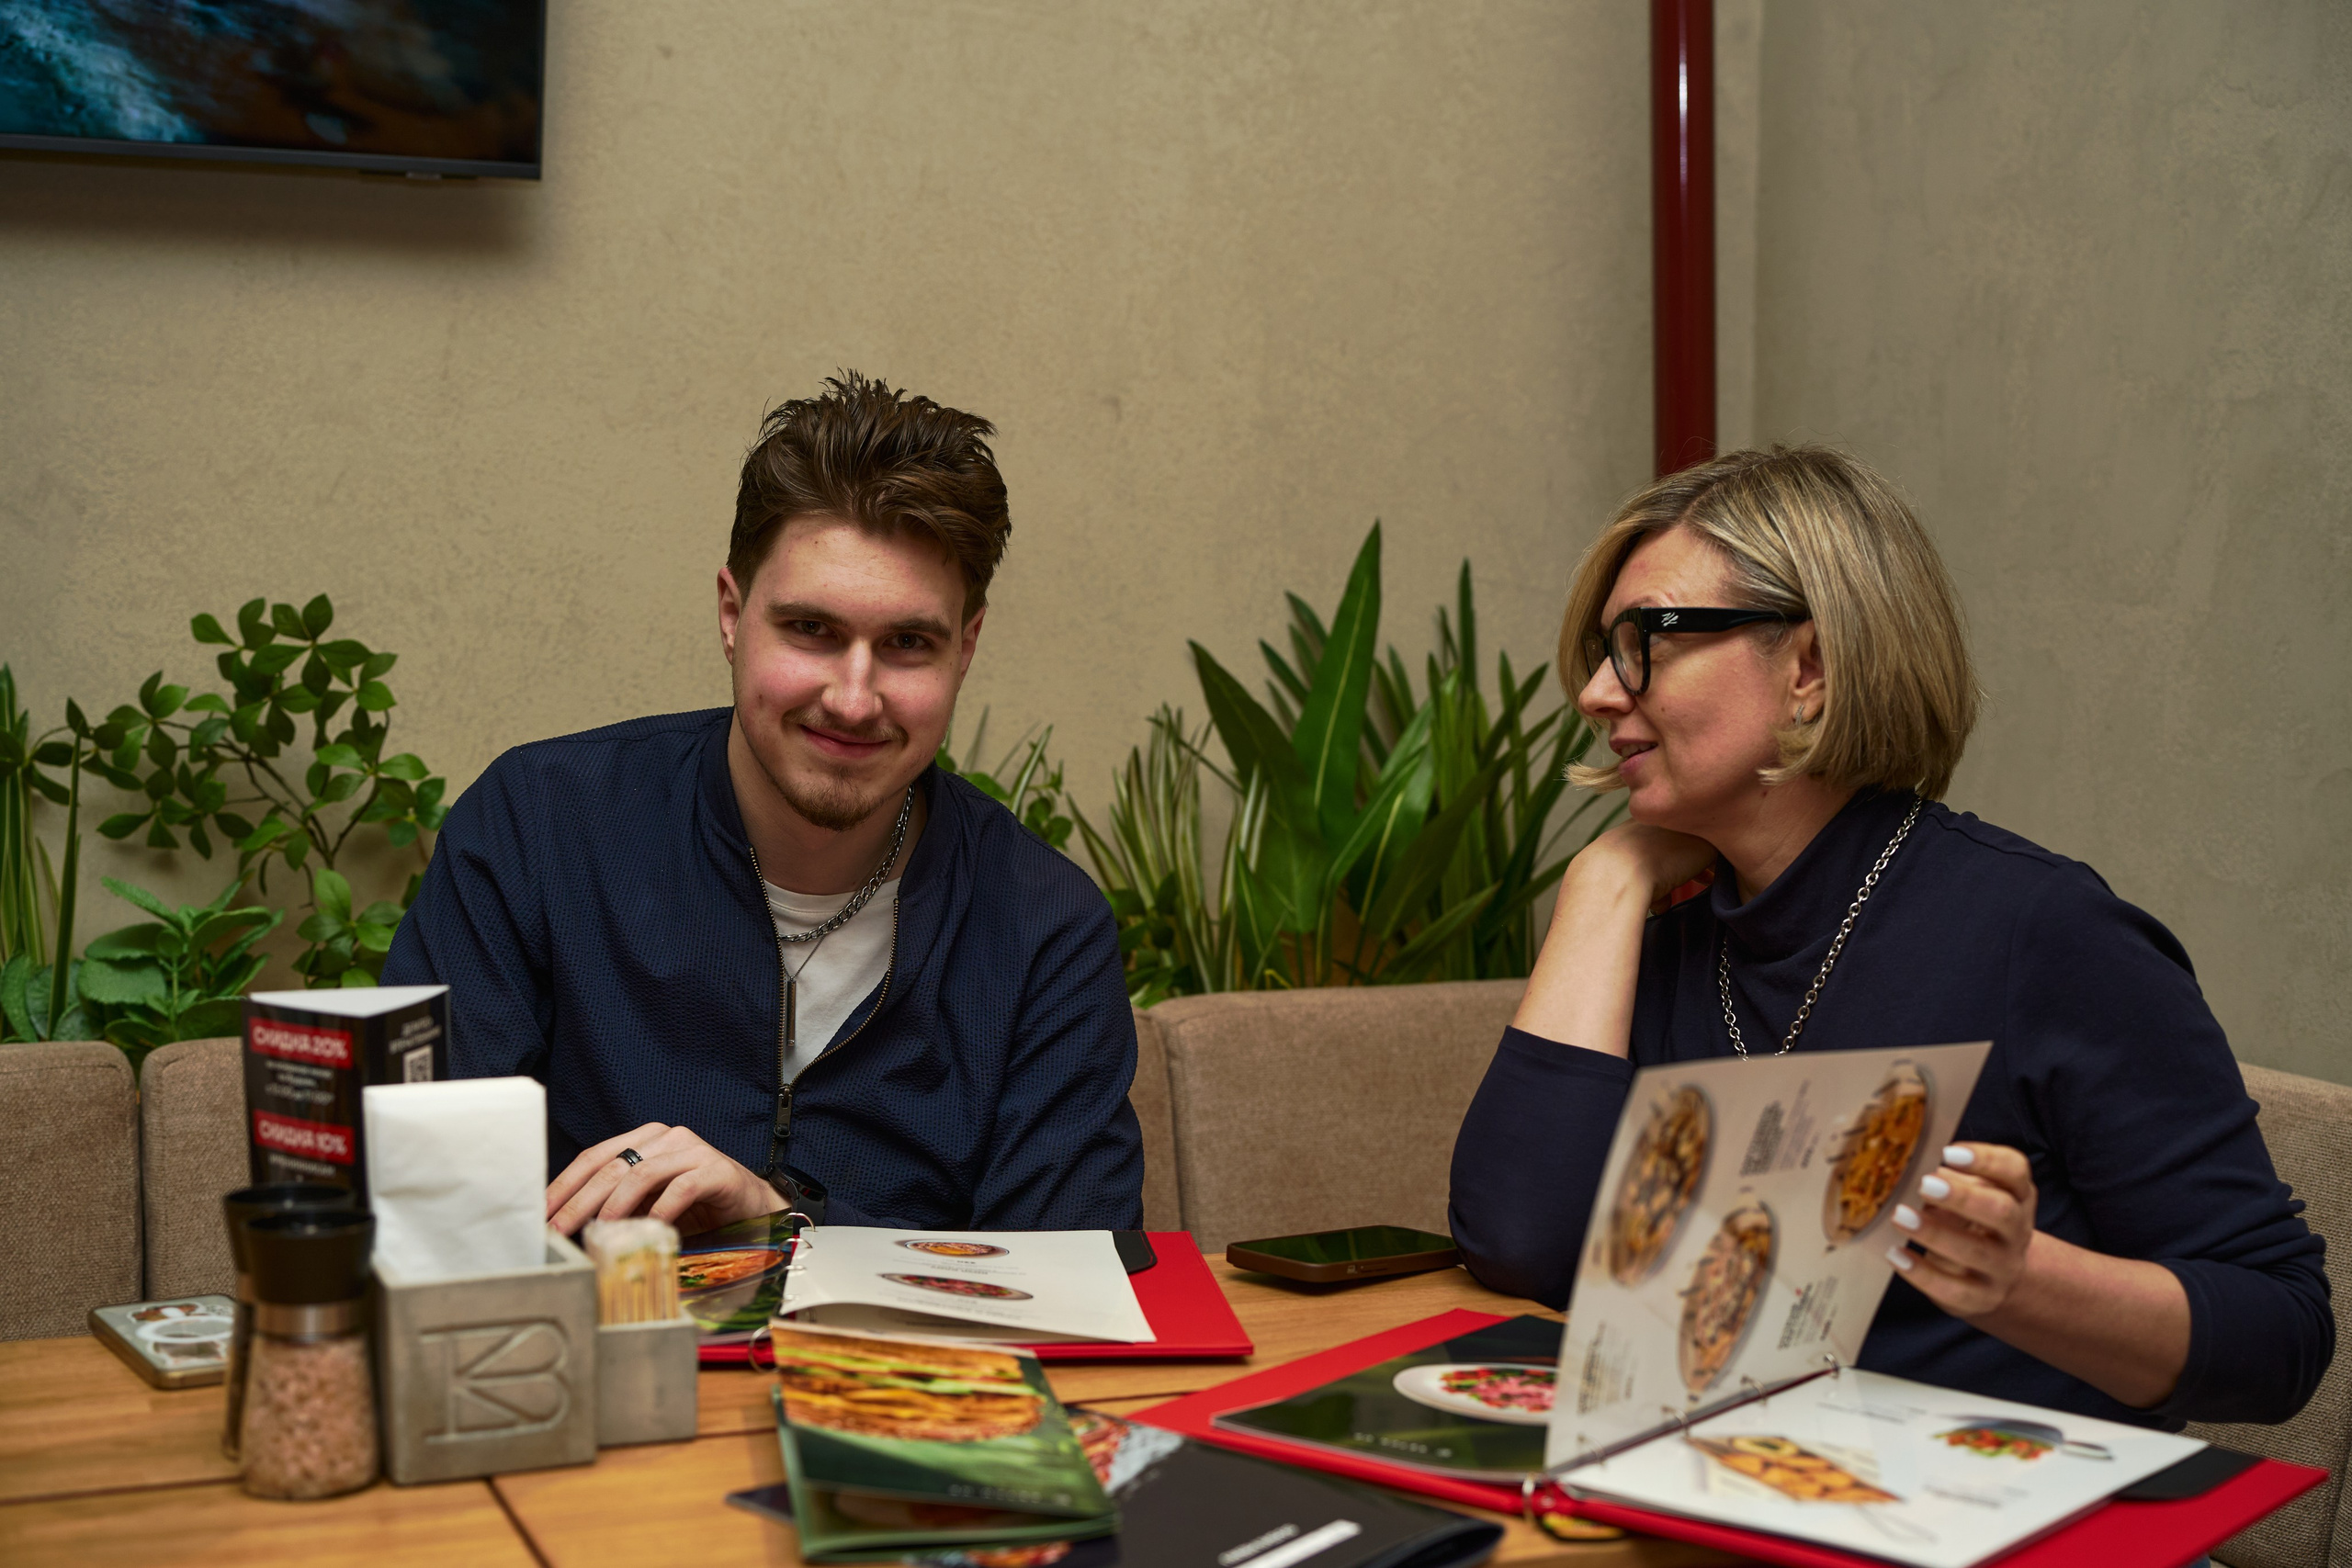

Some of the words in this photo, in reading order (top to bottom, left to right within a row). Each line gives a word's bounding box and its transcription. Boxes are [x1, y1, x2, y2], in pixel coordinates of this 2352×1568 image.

[253, 1026, 311, 1052] СКИДКА
[312, 1036, 348, 1059] 20%
[258, 1120, 314, 1148] СКИДКА
[316, 1132, 347, 1156] 10%
